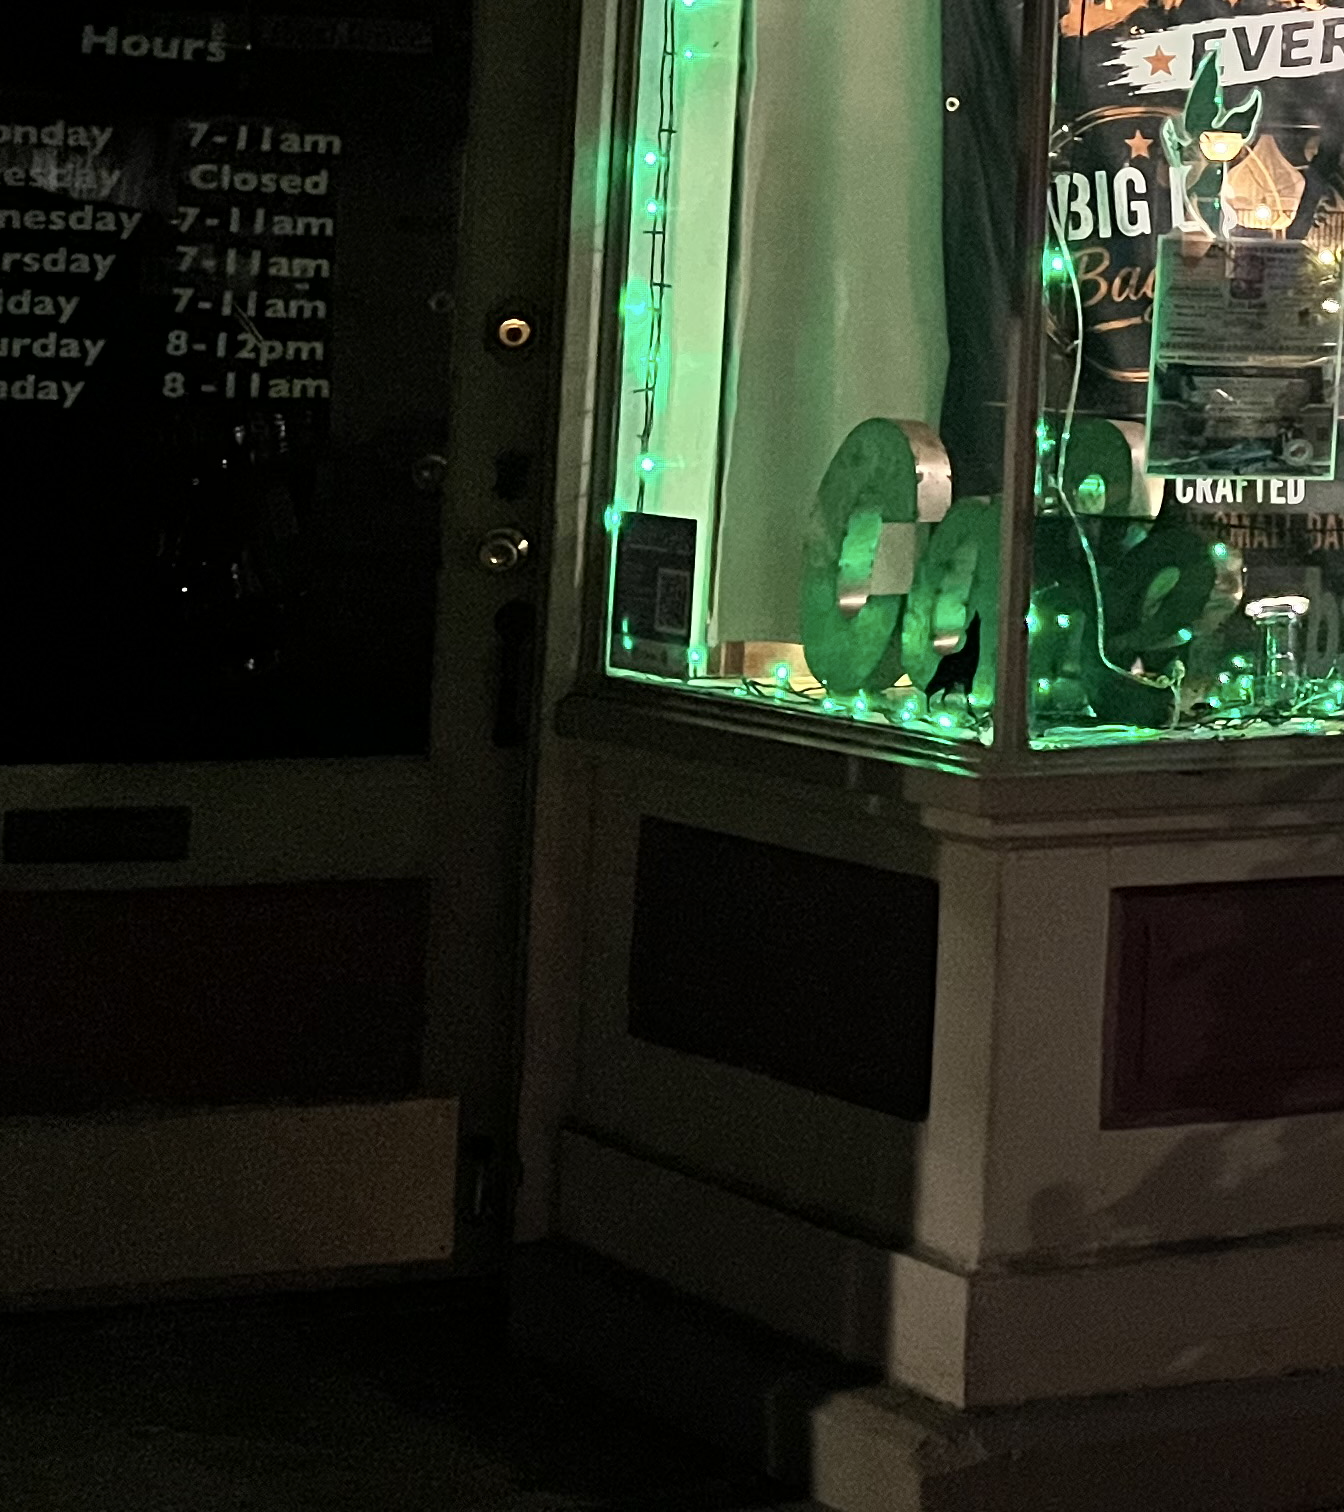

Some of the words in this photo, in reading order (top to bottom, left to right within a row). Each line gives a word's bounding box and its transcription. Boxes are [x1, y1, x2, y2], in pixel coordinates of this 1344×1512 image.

[80, 23, 227, 64] Hours
[187, 121, 343, 155] 7-11am
[189, 163, 330, 196] Closed
[1055, 166, 1152, 241] BIG
[178, 205, 335, 238] 7-11am
[175, 245, 331, 279] 7-11am
[172, 287, 327, 320] 7-11am
[166, 329, 325, 368] 8-12pm
[162, 371, 331, 400] 8-11am
[1174, 477, 1306, 505] CRAFTED
